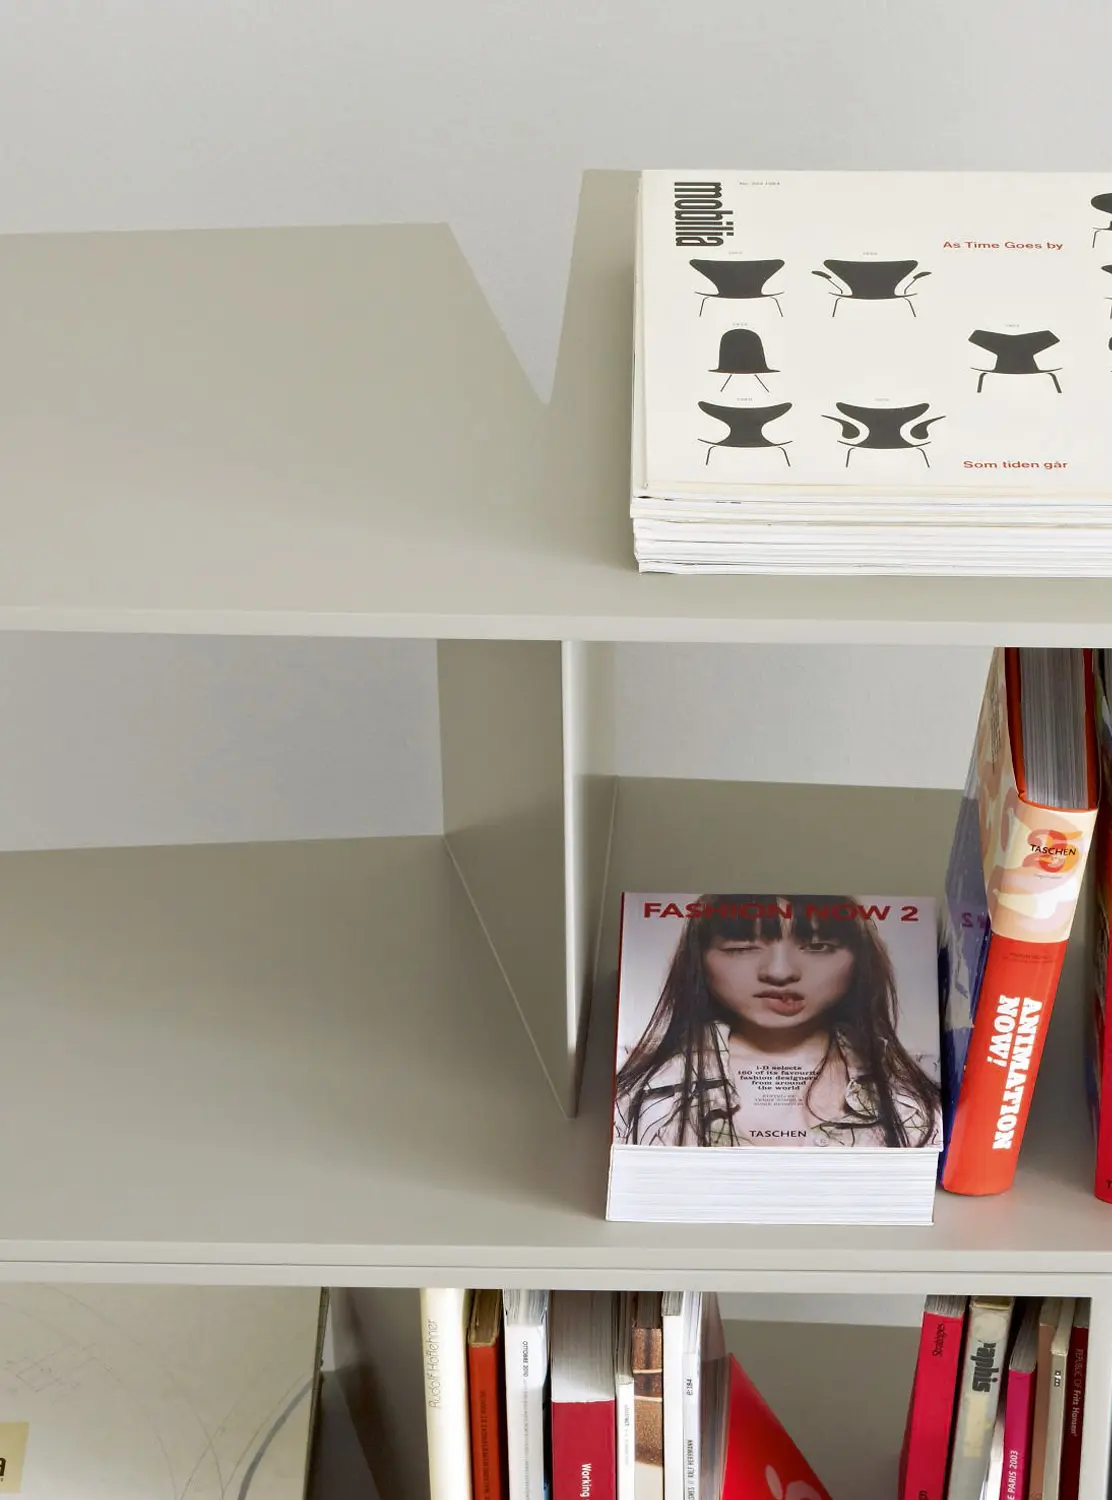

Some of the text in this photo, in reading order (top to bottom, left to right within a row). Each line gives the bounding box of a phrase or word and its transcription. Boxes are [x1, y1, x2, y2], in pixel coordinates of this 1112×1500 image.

[674, 182, 734, 246] mobilia
[943, 241, 1064, 251] As Time Goes by
[963, 460, 1069, 470] Som tiden går
[1030, 842, 1077, 857] TASCHEN
[643, 902, 920, 922] FASHION NOW 2
[987, 994, 1021, 1067] NOW!
[992, 997, 1043, 1150] ANIMATION
[749, 1130, 807, 1138] TASCHEN
[969, 1339, 1000, 1393] raphis
[1010, 1450, 1019, 1470] 2003
[579, 1463, 592, 1498] Working
[1007, 1471, 1018, 1494] PARIS
